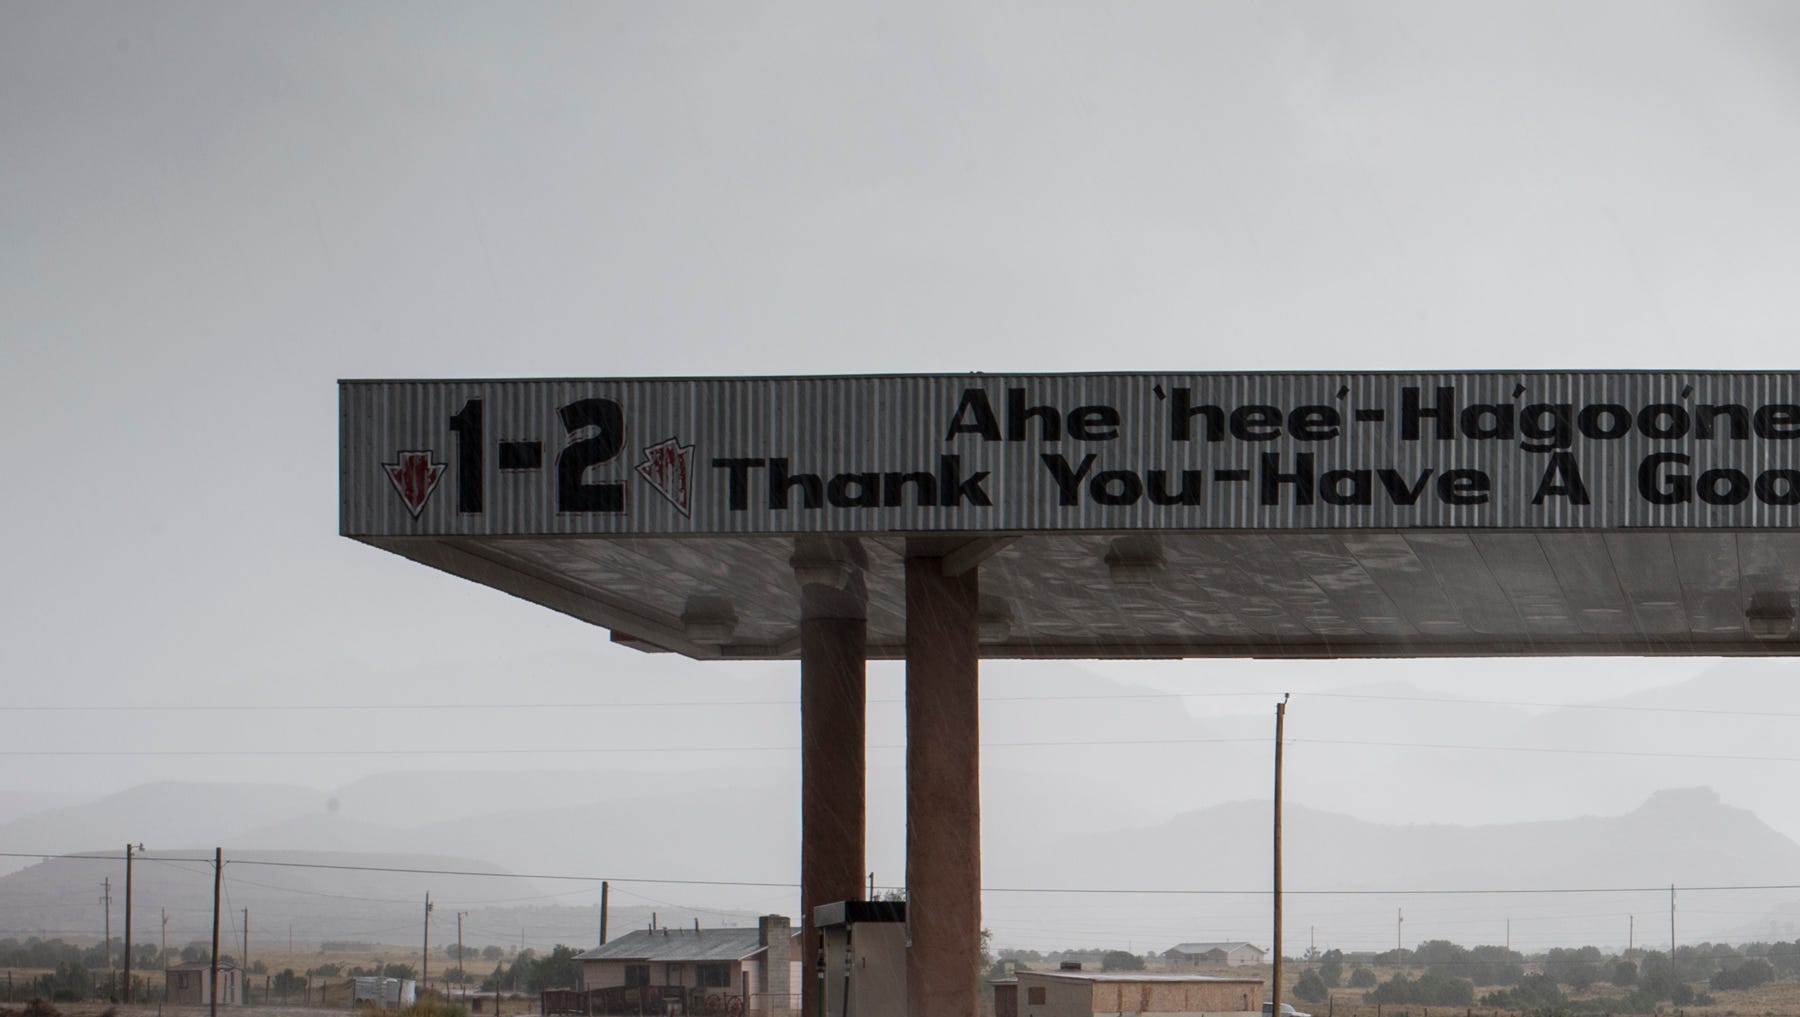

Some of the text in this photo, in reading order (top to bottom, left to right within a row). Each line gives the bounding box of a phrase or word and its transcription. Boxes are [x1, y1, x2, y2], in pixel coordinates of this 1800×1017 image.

[945, 387, 1121, 442] Ahe
[449, 397, 628, 515] 1-2
[712, 453, 993, 510] Thank
[1040, 451, 1490, 506] You-Have
[1532, 450, 1591, 505] A
